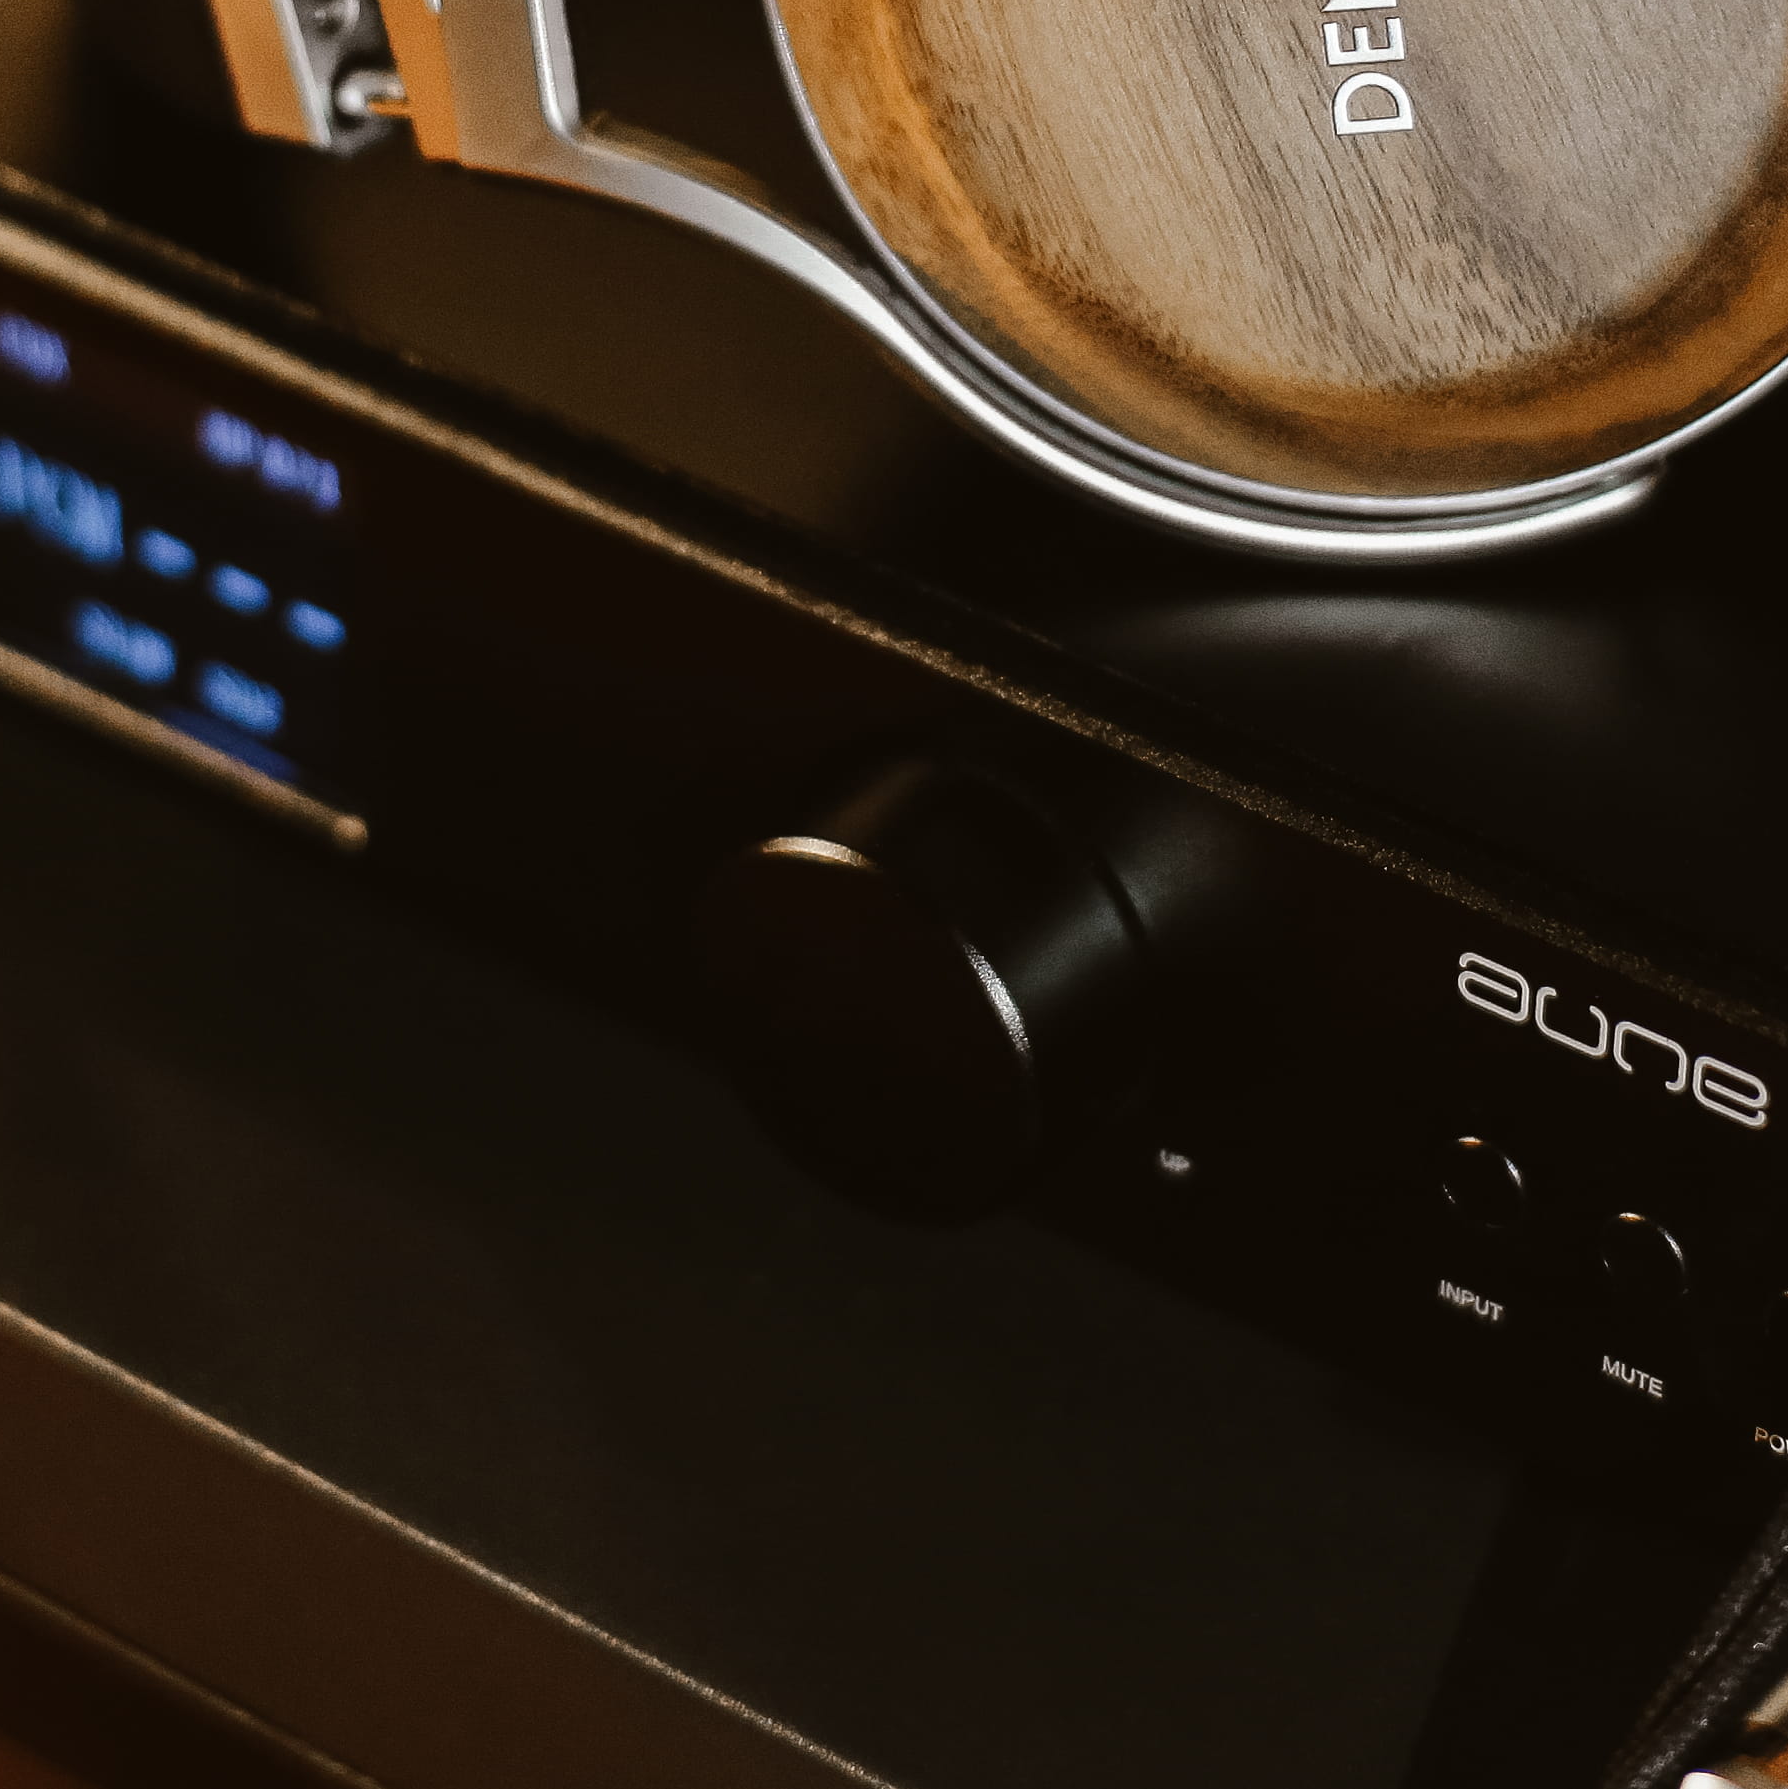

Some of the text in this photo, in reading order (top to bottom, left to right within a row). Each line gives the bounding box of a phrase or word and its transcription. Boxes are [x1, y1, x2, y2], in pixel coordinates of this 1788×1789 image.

[1457, 951, 1770, 1129] aune
[1437, 1278, 1505, 1323] INPUT
[1601, 1354, 1665, 1400] MUTE
